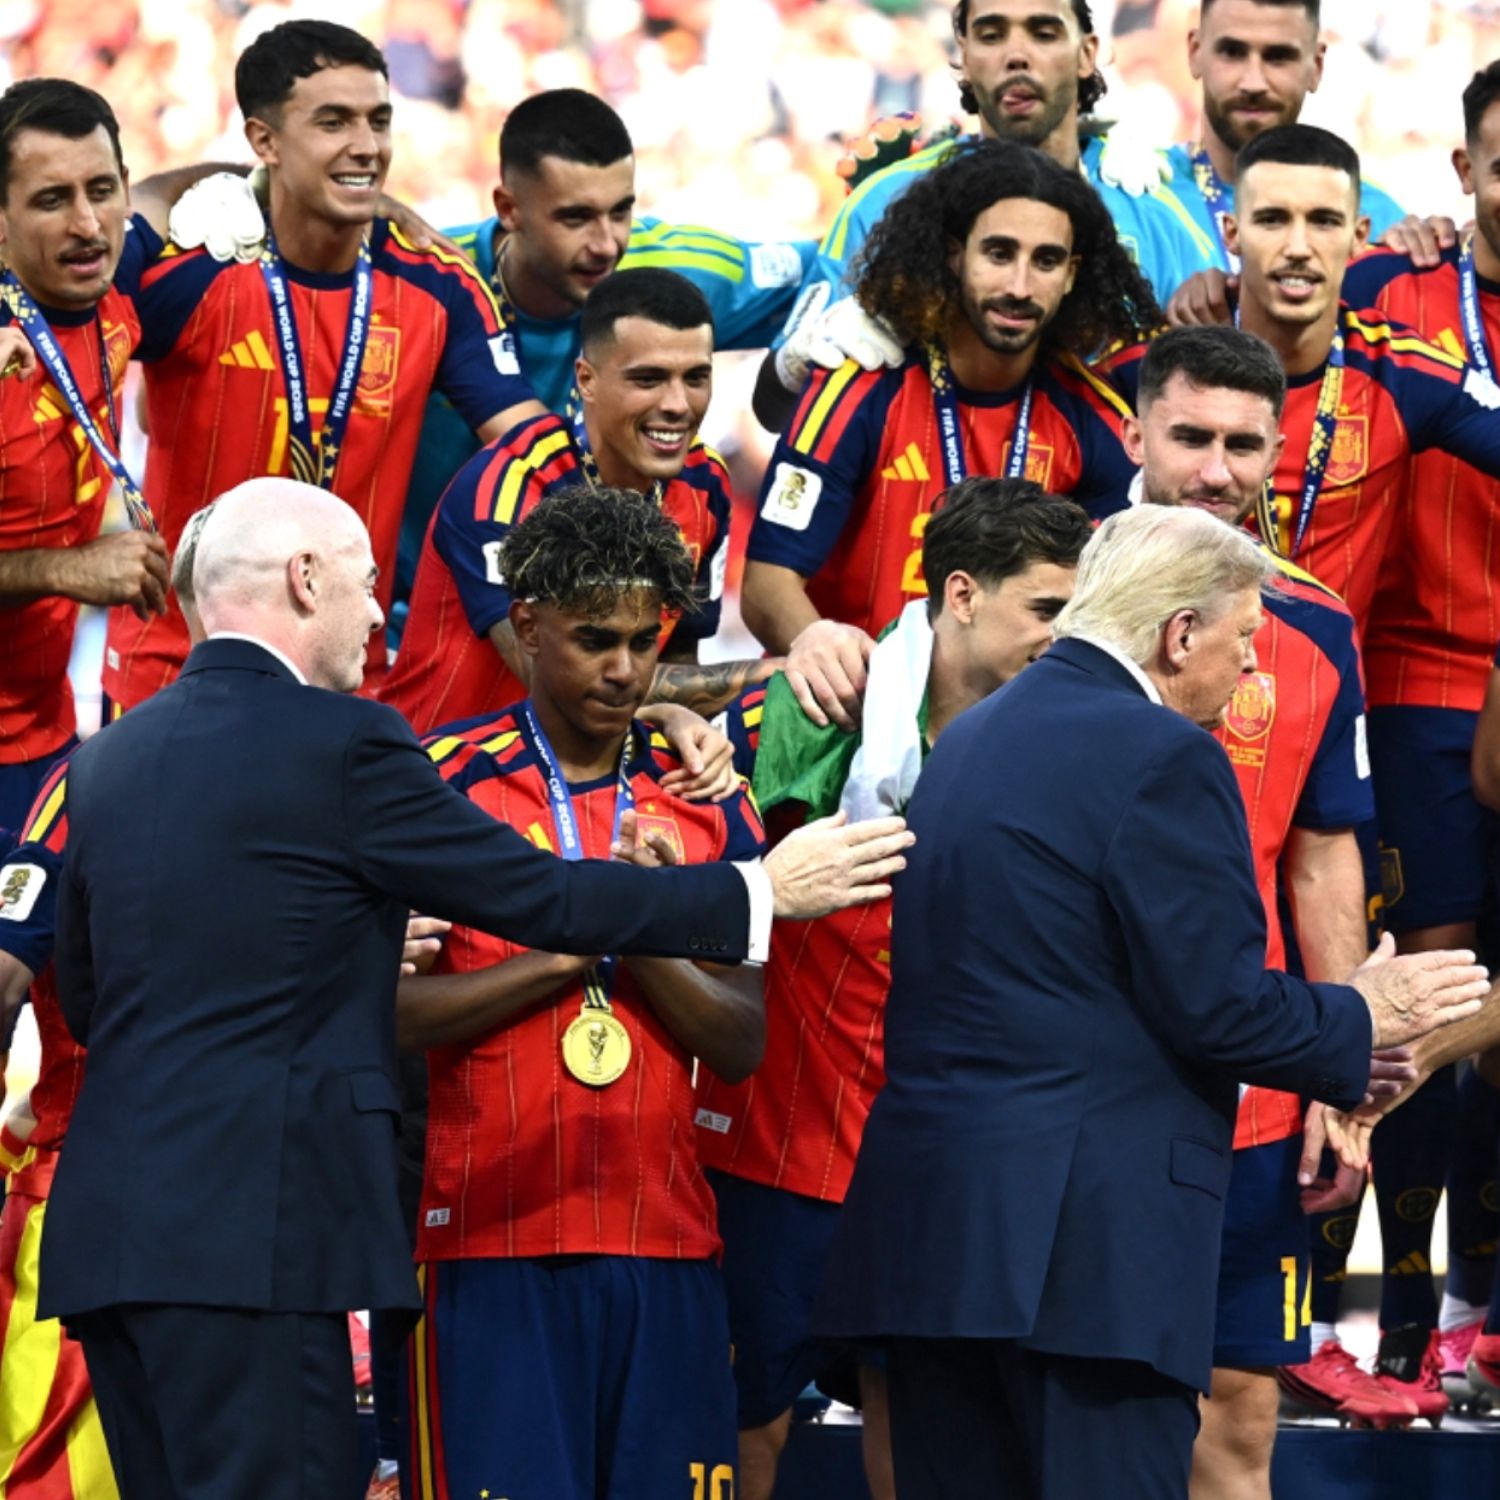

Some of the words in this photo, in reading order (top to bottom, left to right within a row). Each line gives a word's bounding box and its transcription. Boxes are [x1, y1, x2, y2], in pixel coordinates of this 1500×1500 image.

[271, 276, 287, 305] FIFA
[277, 302, 295, 351] WORLD
[350, 316, 364, 343] CUP
[286, 350, 300, 379] CUP
[342, 341, 361, 394] WORLD
[37, 331, 57, 359] FIFA
[52, 355, 80, 403] WORLD
[75, 402, 92, 428] CUP
[332, 391, 349, 418] FIFA
[941, 407, 956, 435] FIFA
[946, 434, 962, 485] WORLD
[549, 777, 567, 801] CUP
[557, 802, 577, 849] 2026
